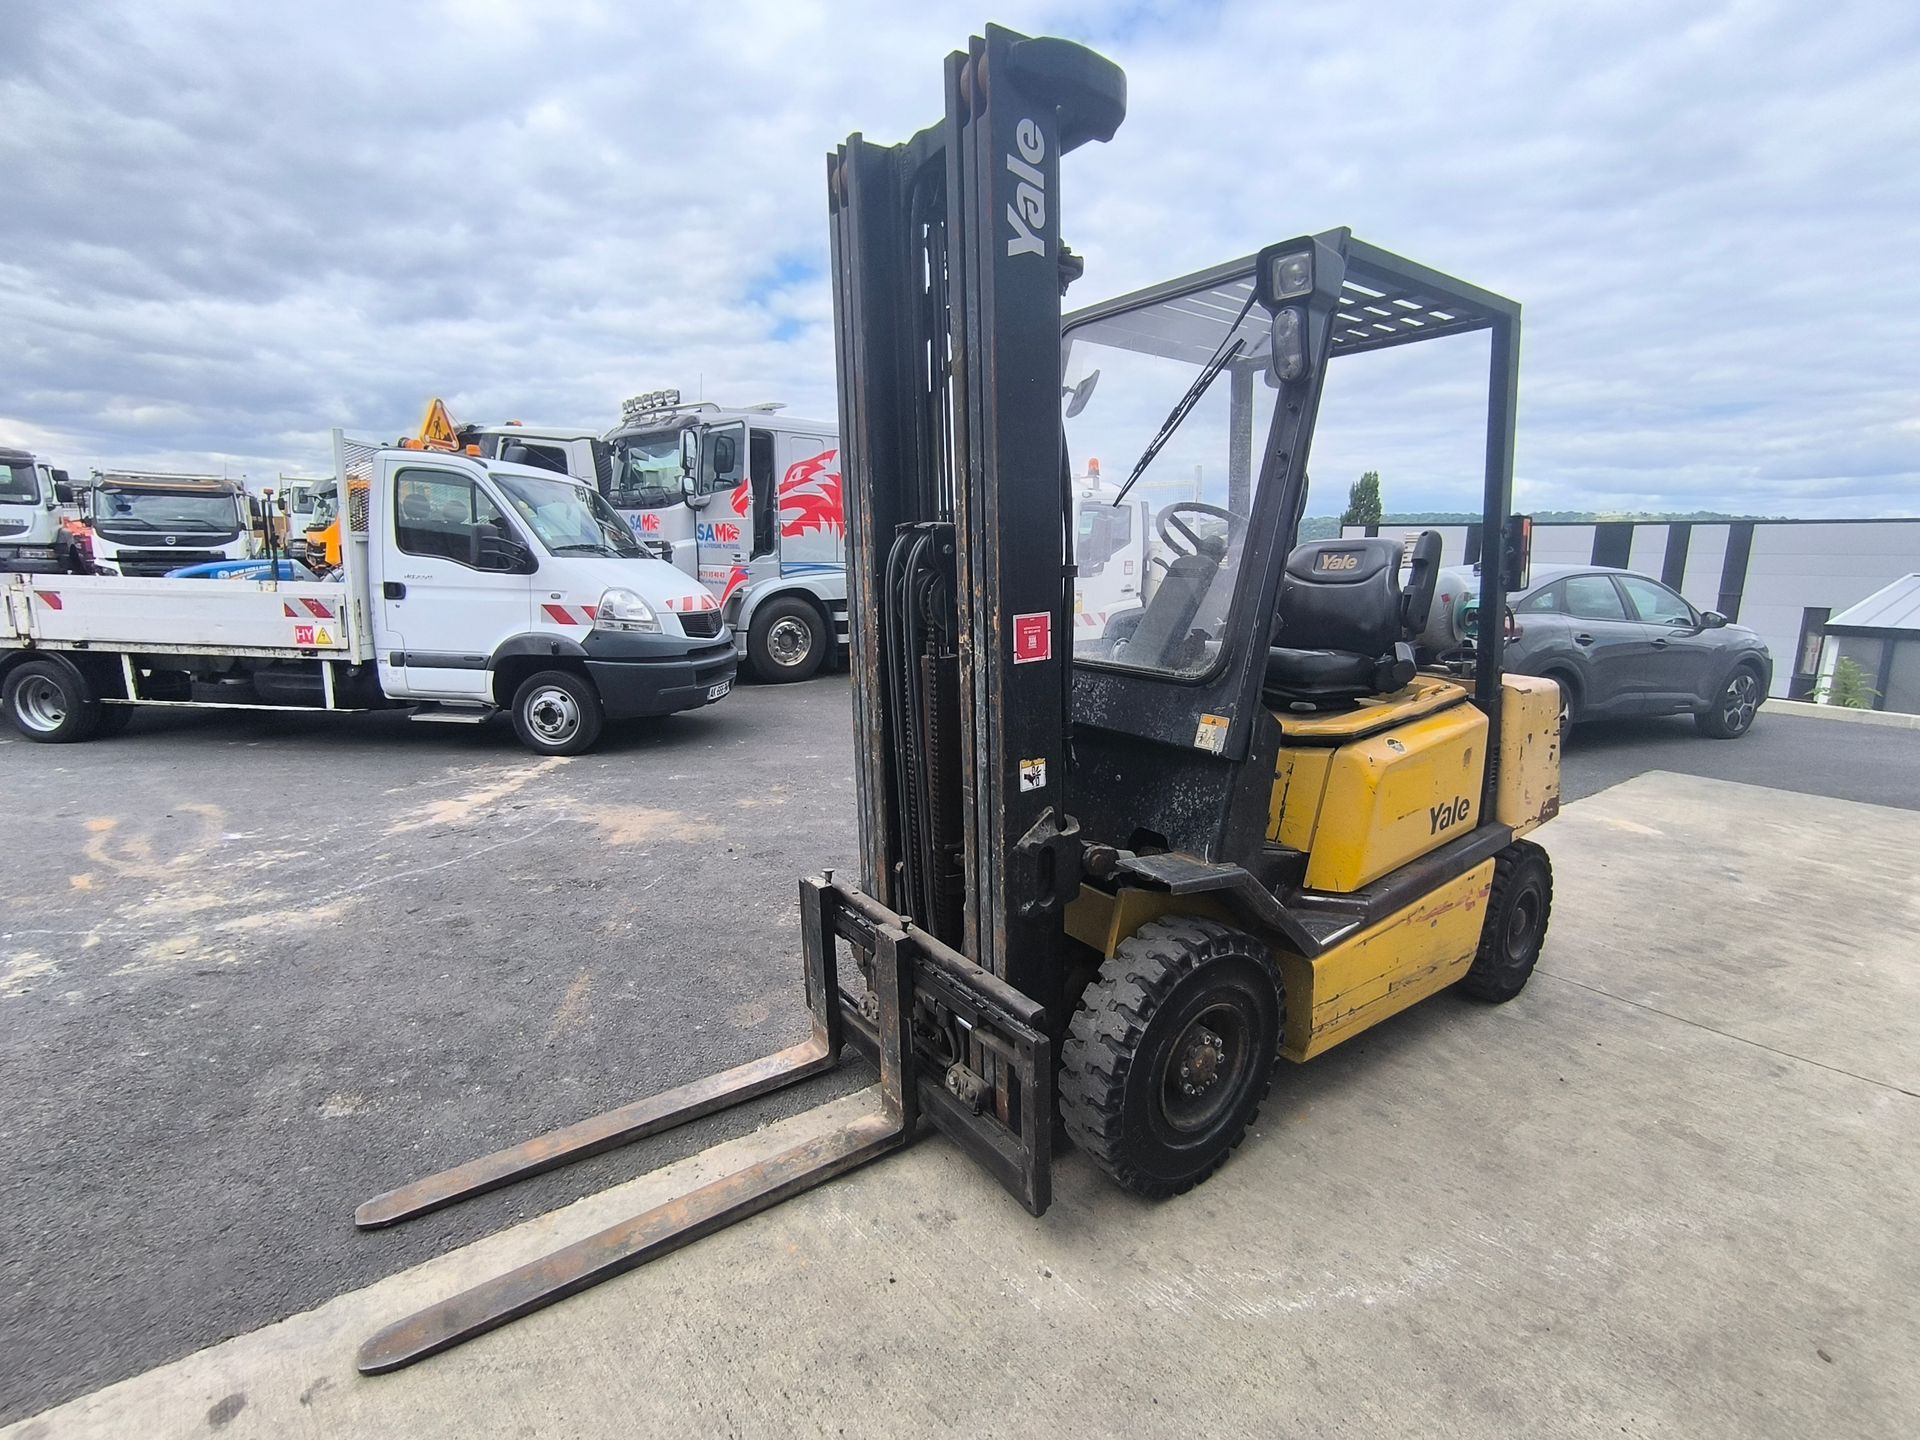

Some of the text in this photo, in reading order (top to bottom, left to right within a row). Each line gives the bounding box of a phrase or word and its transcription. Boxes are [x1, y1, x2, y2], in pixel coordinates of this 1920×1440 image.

[1007, 118, 1045, 257] Yale
[630, 514, 650, 531] SAM
[697, 523, 726, 542] SAM
[1321, 554, 1358, 570] Yale
[296, 628, 313, 640] HY
[1430, 795, 1470, 836] Yale
